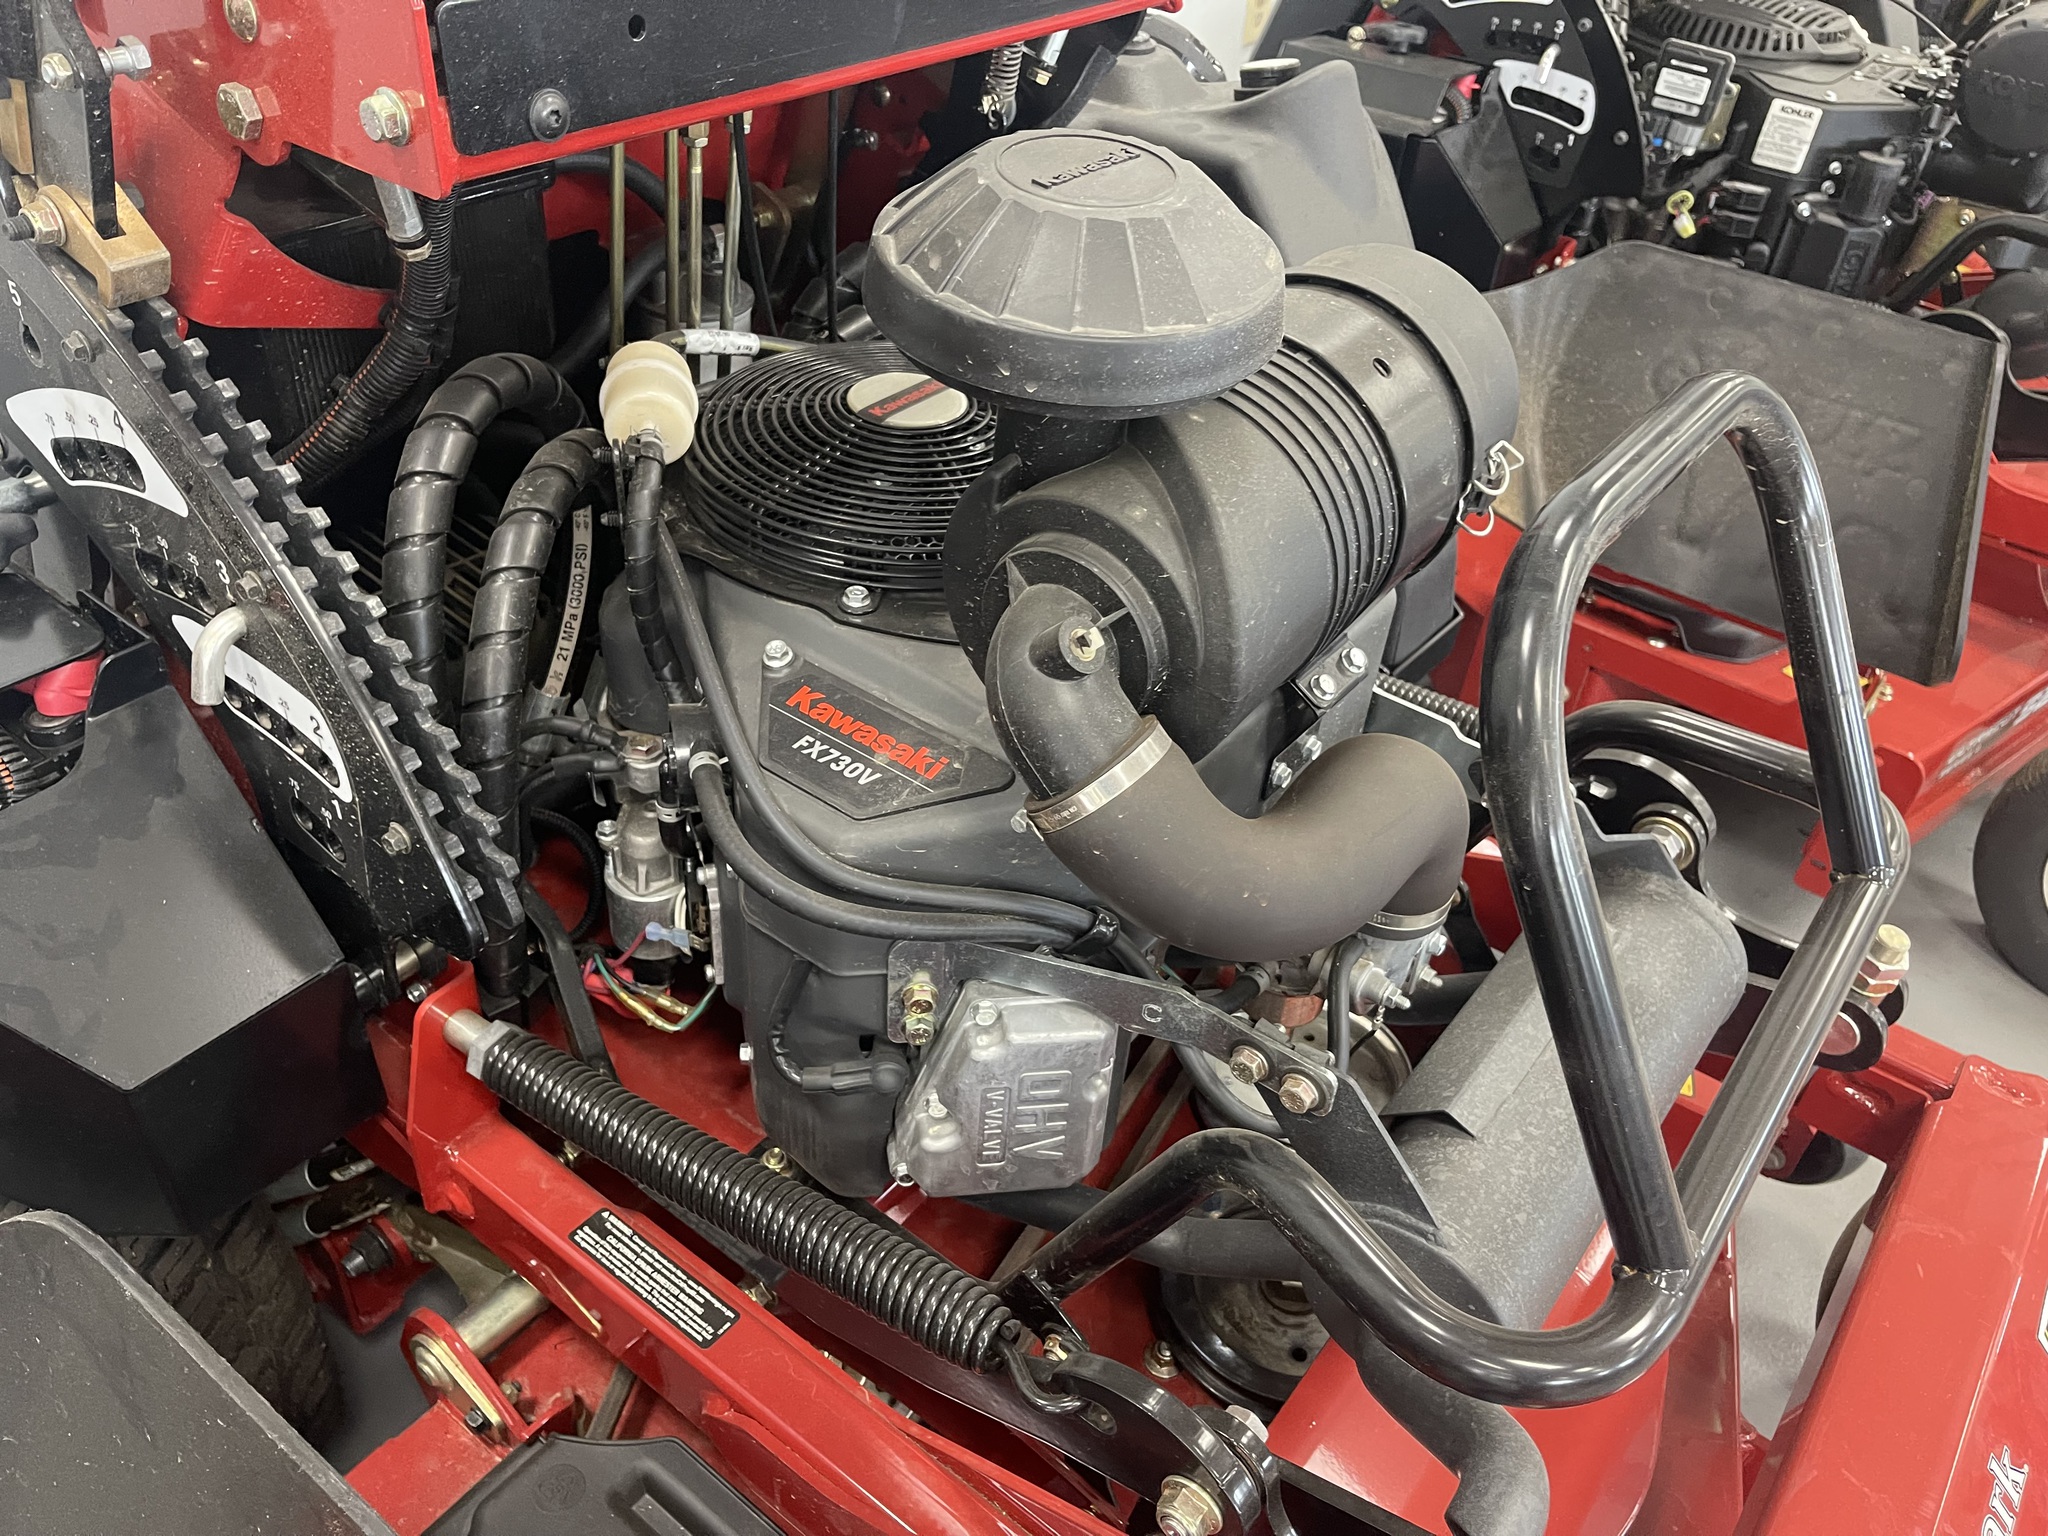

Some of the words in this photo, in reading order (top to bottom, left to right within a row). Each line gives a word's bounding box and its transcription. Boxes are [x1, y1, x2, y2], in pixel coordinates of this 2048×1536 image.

[1030, 147, 1141, 190] Kawasaki
[7, 279, 22, 307] 5
[112, 409, 125, 436] 4
[573, 543, 589, 571] PSI)
[215, 558, 231, 585] 3
[561, 613, 579, 642] MPa
[556, 646, 571, 662] 21
[309, 714, 324, 740] 2
[785, 684, 950, 780] Kawasaki
[791, 733, 883, 786] FX730V
[1012, 1069, 1073, 1160] OHV
